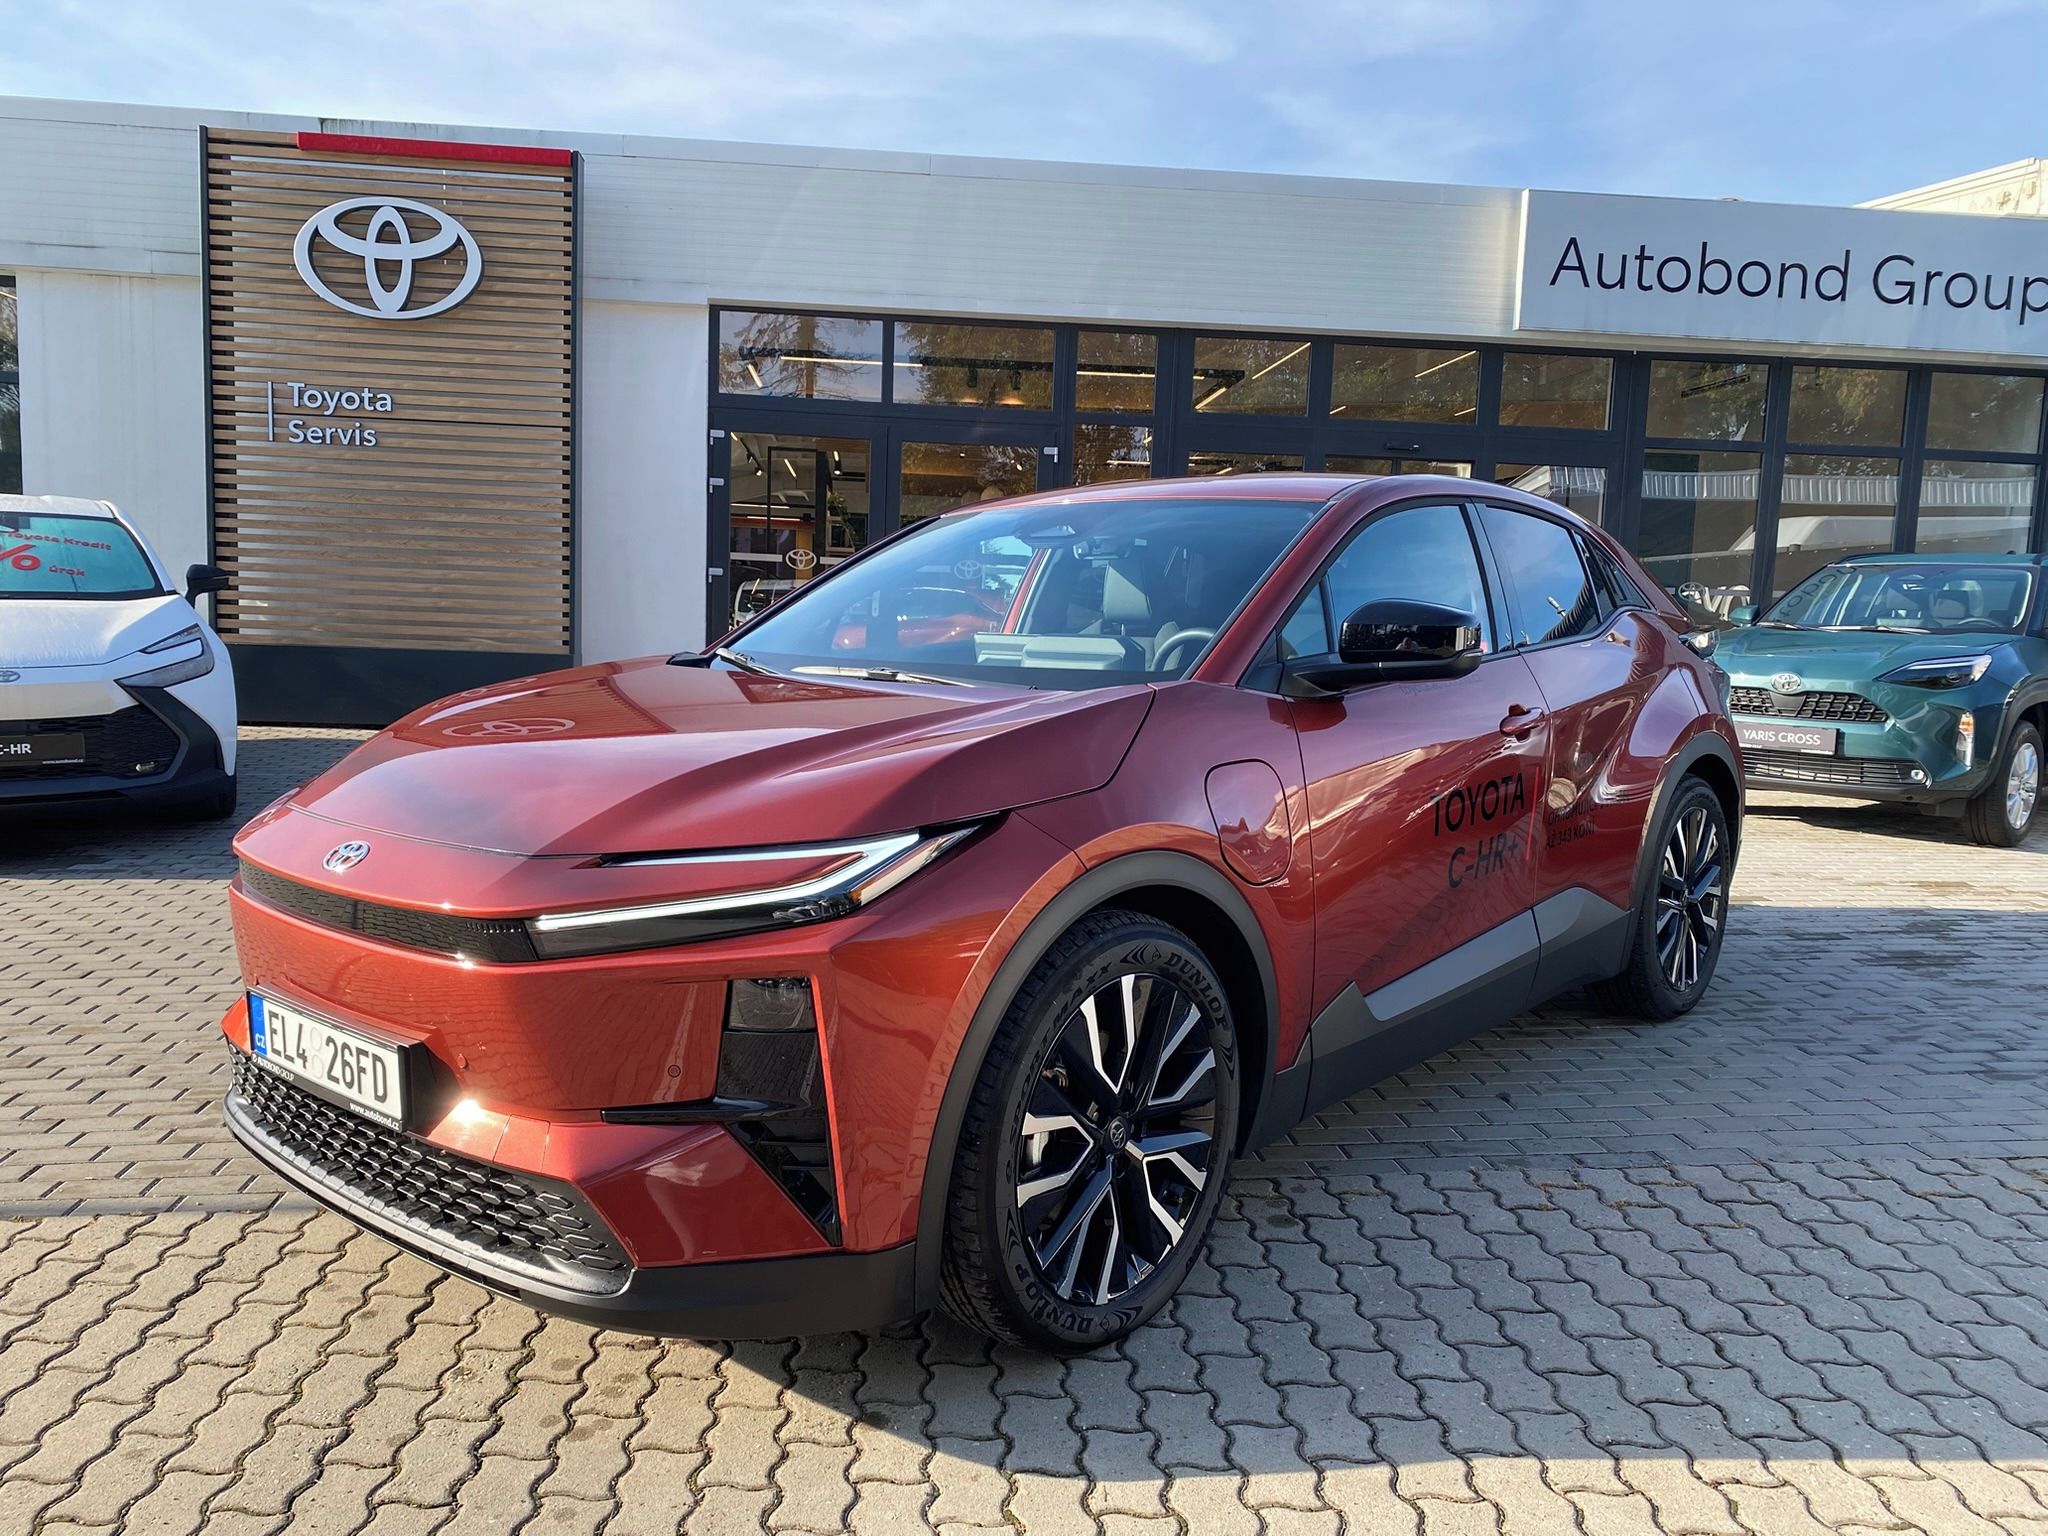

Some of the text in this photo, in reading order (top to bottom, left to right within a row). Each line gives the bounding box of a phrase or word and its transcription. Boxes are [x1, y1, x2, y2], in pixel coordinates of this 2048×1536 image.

[1549, 236, 2048, 326] Autobond Group
[287, 381, 393, 417] Toyota
[287, 420, 378, 448] Servis
[8, 531, 112, 551] Toyota Kredit
[1743, 729, 1821, 745] YARIS CROSS
[1430, 772, 1524, 837] TOYOTA
[1448, 832, 1519, 889] C-HR+
[1164, 951, 1233, 1032] DUNLOP
[255, 1032, 266, 1049] CZ
[325, 1035, 388, 1104] 26FD
[350, 1102, 399, 1130] www.autobond.cz
